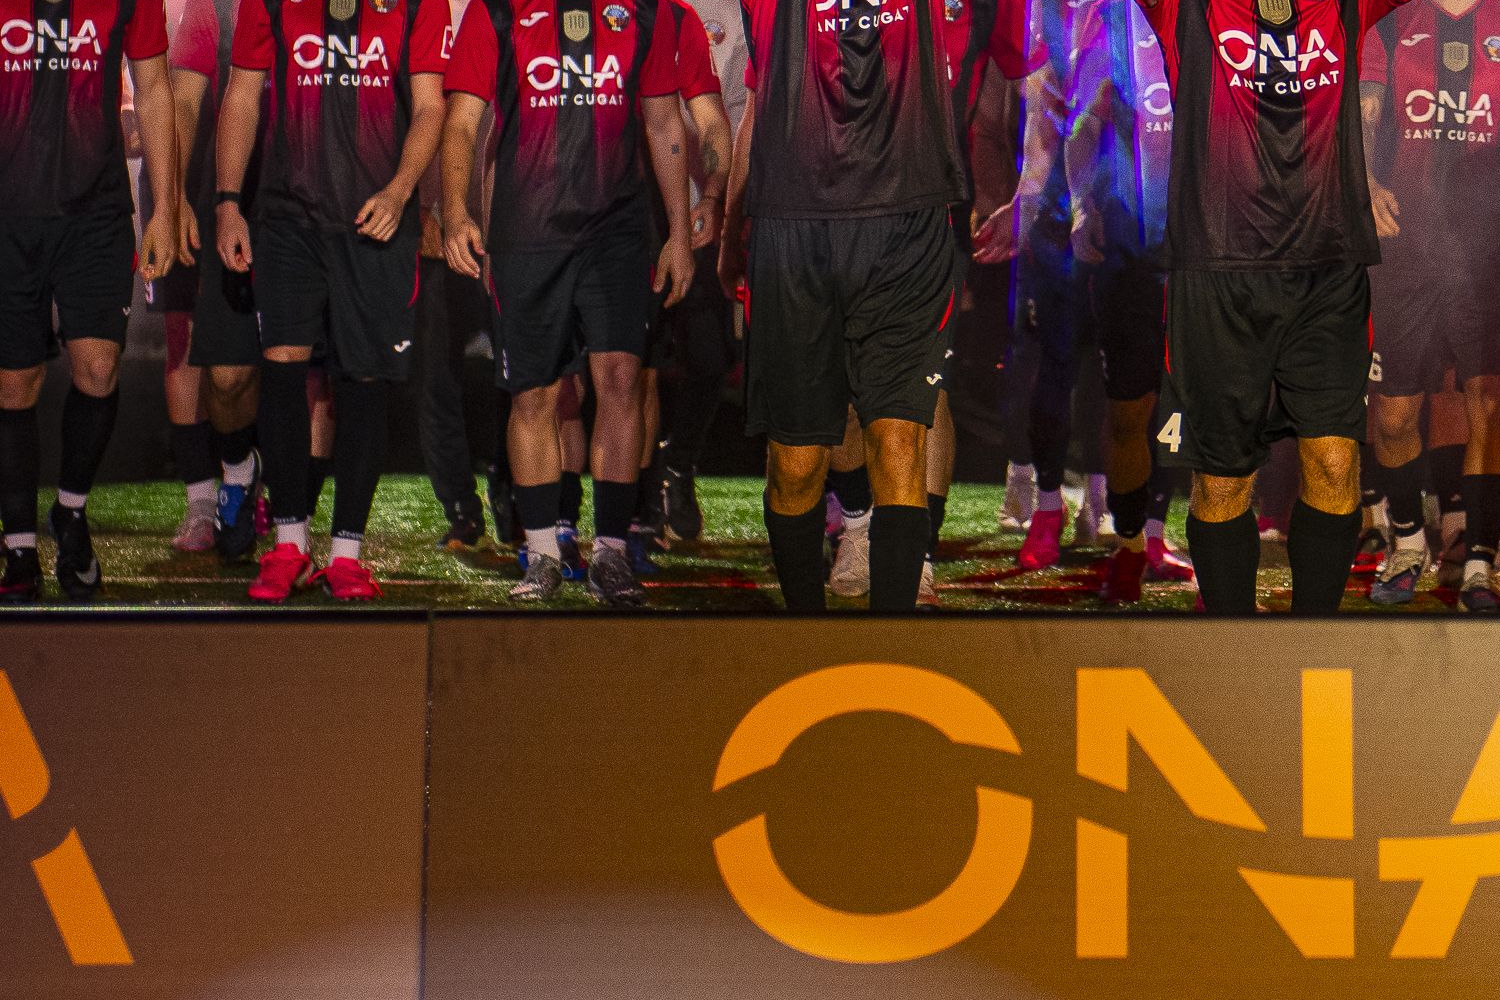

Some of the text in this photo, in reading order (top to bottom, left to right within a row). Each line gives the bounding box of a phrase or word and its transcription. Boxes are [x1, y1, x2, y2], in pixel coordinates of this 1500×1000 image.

[1, 18, 102, 55] ONA
[293, 34, 389, 70] ONA
[1218, 28, 1340, 74] ONA
[4, 57, 98, 72] SANT CUGAT
[297, 74, 390, 87] SANT CUGAT
[526, 54, 624, 91] ONA
[1229, 70, 1340, 95] ANT CUGAT
[530, 93, 624, 108] SANT CUGAT
[1405, 89, 1493, 126] ONA
[1404, 129, 1493, 142] SANT CUGAT
[1156, 412, 1182, 453] 4
